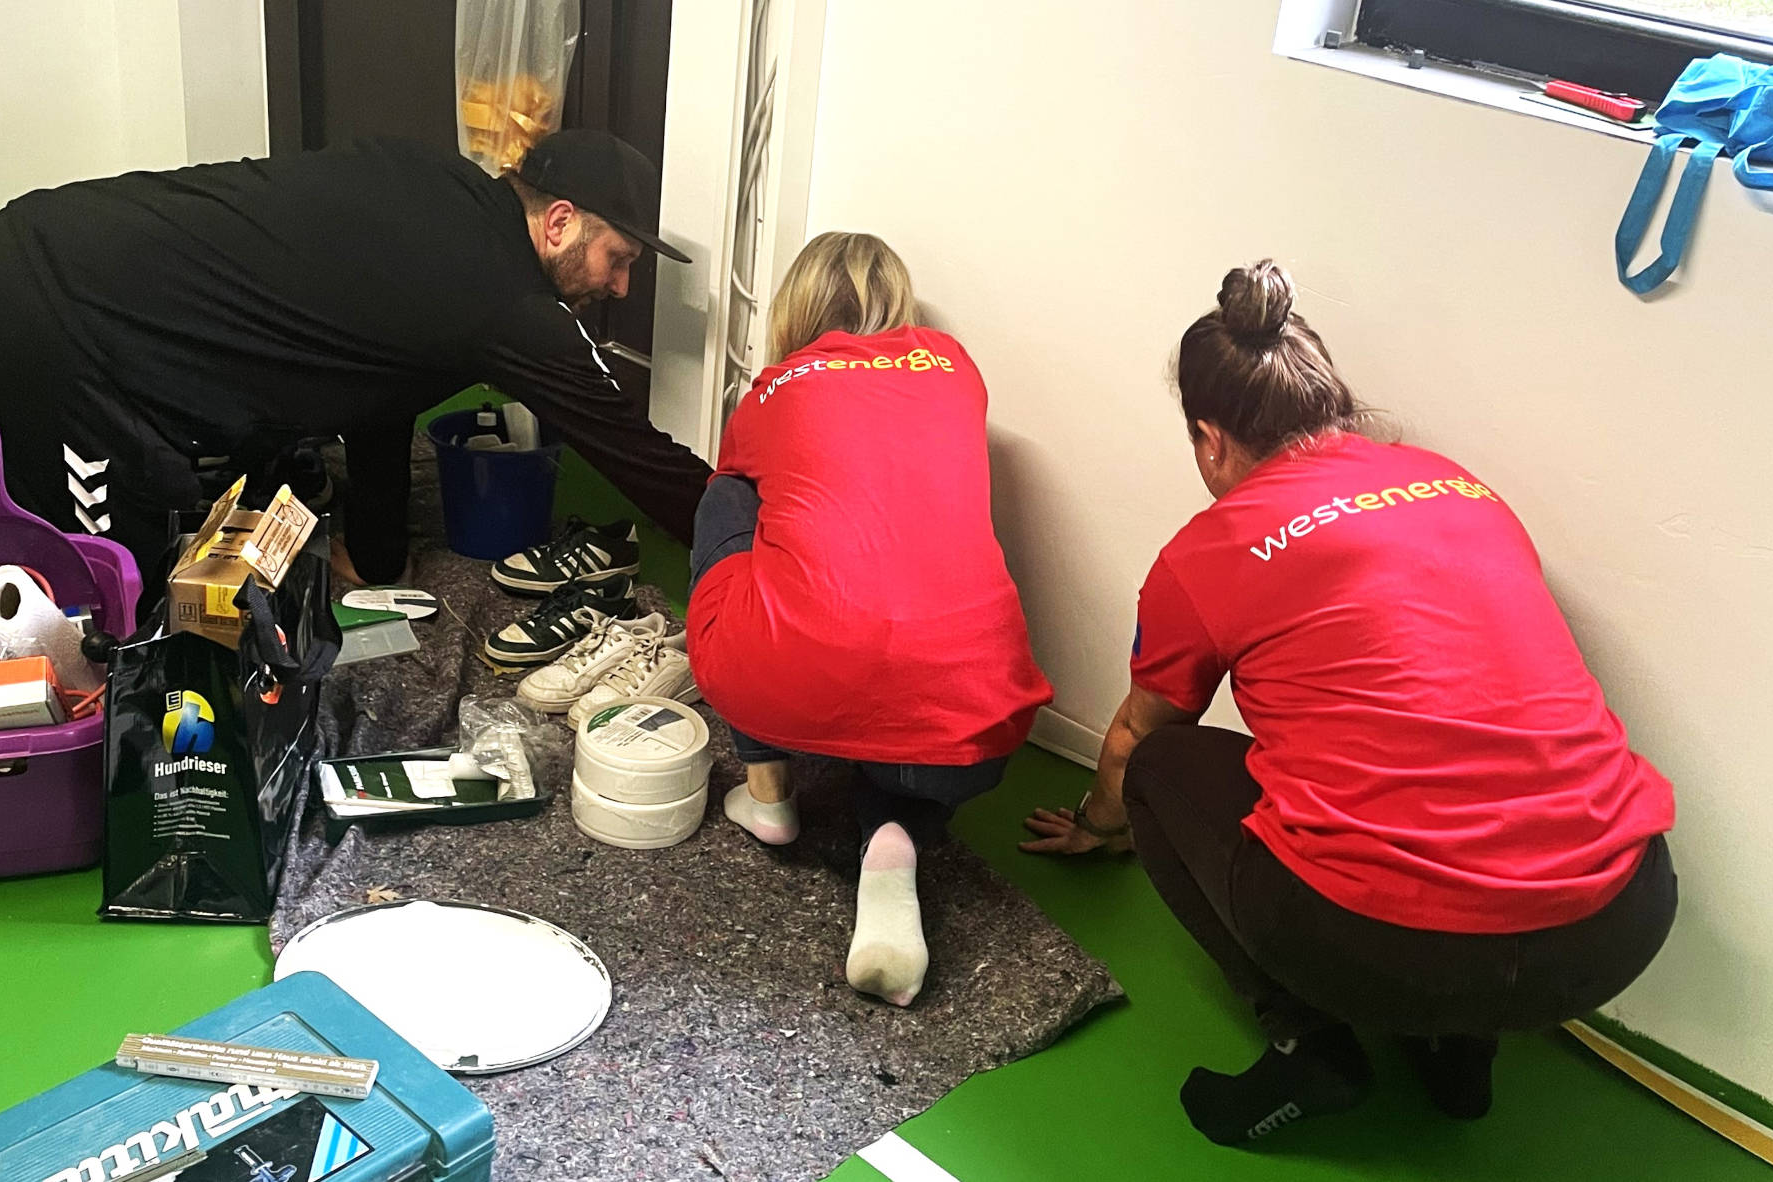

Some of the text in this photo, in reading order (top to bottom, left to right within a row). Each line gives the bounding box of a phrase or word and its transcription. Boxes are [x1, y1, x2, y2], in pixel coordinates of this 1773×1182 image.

[759, 348, 955, 404] westenergie
[1250, 476, 1498, 562] westenergie
[154, 756, 227, 778] Hundrieser
[154, 791, 167, 800] Das
[169, 789, 179, 798] ist
